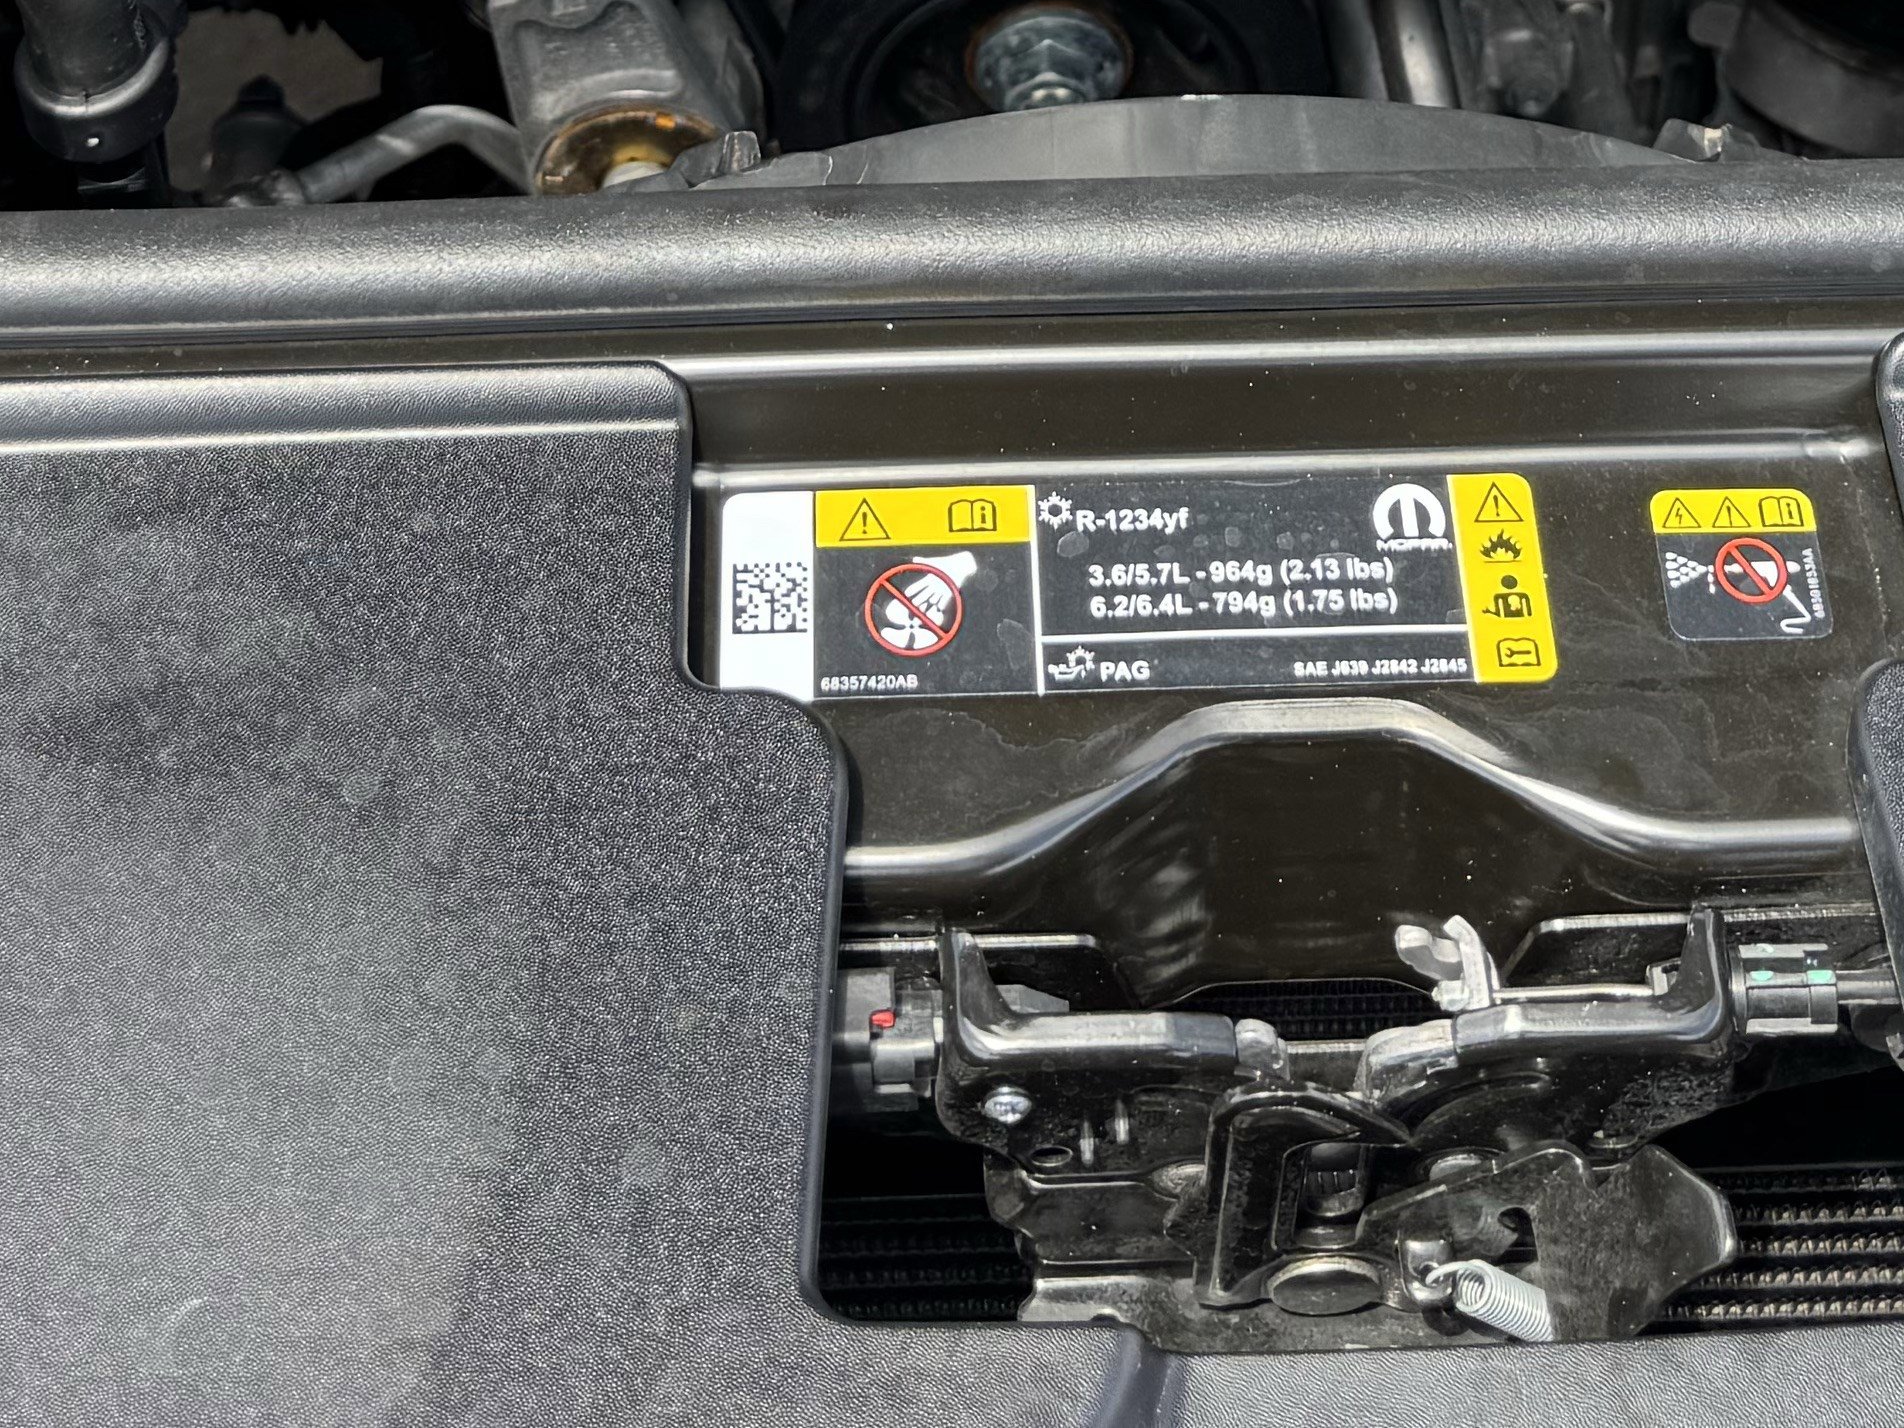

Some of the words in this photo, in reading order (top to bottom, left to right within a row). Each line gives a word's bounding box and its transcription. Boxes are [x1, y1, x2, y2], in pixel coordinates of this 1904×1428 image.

[1076, 507, 1189, 536] R-1234yf
[1088, 563, 1191, 588] 3.6/5.7L
[1210, 561, 1273, 589] 964g
[1280, 557, 1342, 586] (2.13
[1346, 556, 1394, 585] lbs)
[1089, 594, 1193, 619] 6.2/6.4L
[1213, 591, 1276, 619] 794g
[1283, 588, 1344, 617] (1.75
[1349, 586, 1398, 615] lbs)
[820, 673, 919, 691] 68357420AB
[1100, 660, 1151, 682] PAG
[1293, 660, 1328, 678] SAE
